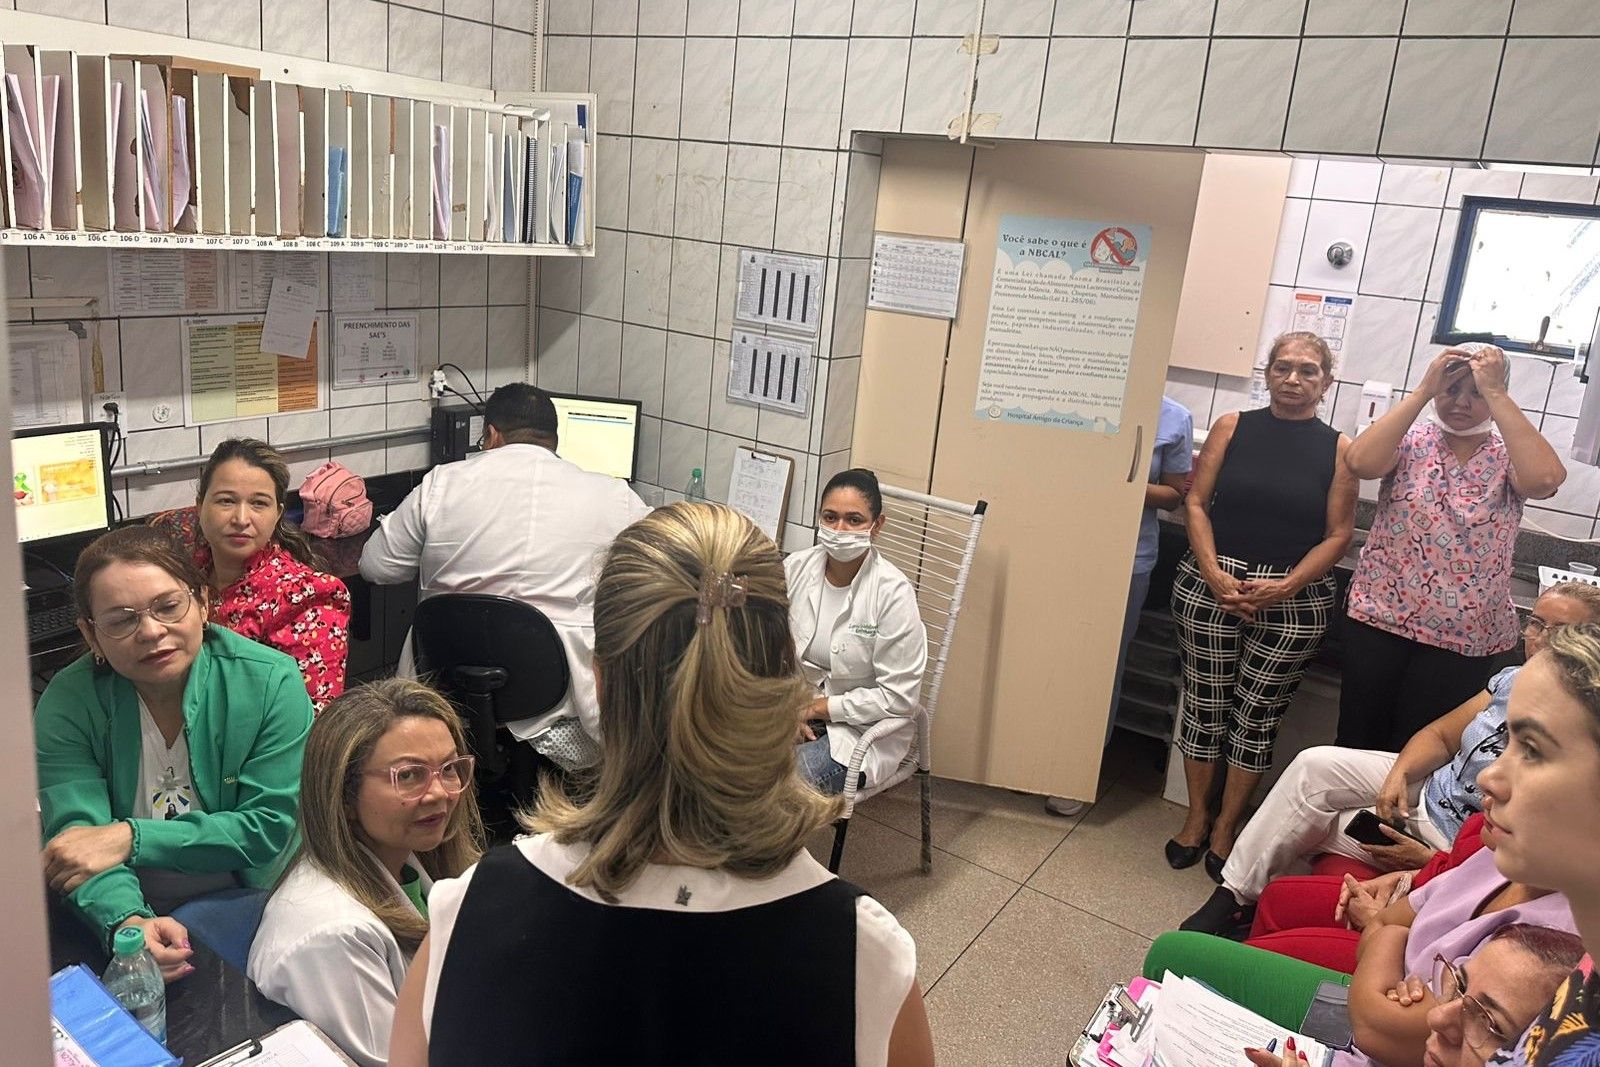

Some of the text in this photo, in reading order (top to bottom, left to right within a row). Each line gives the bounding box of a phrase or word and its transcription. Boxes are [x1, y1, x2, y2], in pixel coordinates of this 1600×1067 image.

[1002, 233, 1024, 243] Você
[1027, 236, 1049, 245] sabe
[1059, 240, 1078, 248] que
[1027, 248, 1066, 259] NBCAL?
[344, 321, 397, 329] PREENCHIMENTO
